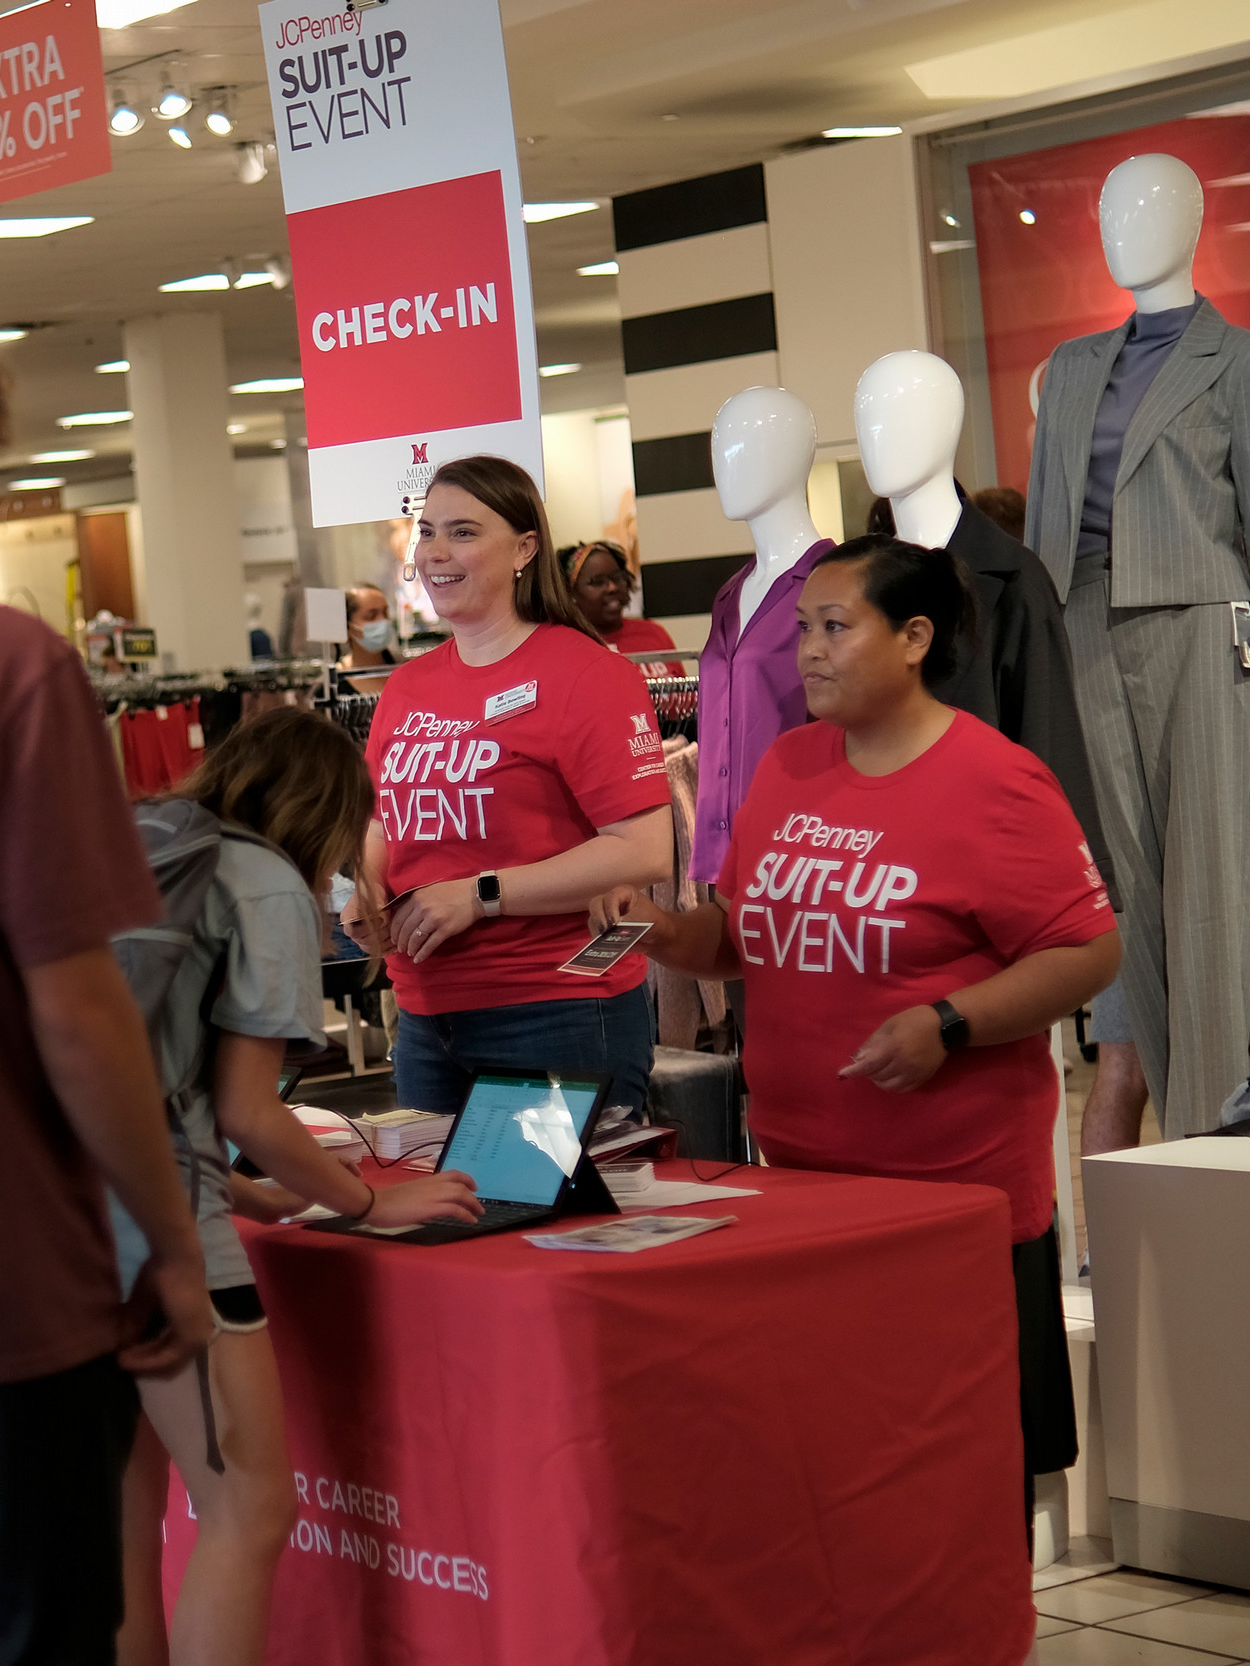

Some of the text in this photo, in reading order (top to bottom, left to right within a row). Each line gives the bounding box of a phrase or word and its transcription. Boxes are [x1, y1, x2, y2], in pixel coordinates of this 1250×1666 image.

[276, 11, 363, 49] JCPenney
[279, 30, 407, 98] SUIT-UP
[286, 76, 411, 151] EVENT
[312, 282, 498, 352] CHECK-IN
[406, 465, 436, 479] MIAMI
[393, 711, 480, 737] JCPenney
[627, 733, 660, 750] MIAMI
[381, 740, 500, 784] SUIT-UP
[380, 787, 494, 841] EVENT
[773, 813, 884, 858] JCPenney
[746, 852, 918, 911] SUIT-UP
[739, 904, 906, 974] EVENT
[316, 1477, 400, 1529] CAREER
[340, 1529, 380, 1570] AND
[387, 1542, 489, 1601] SUCCESS
